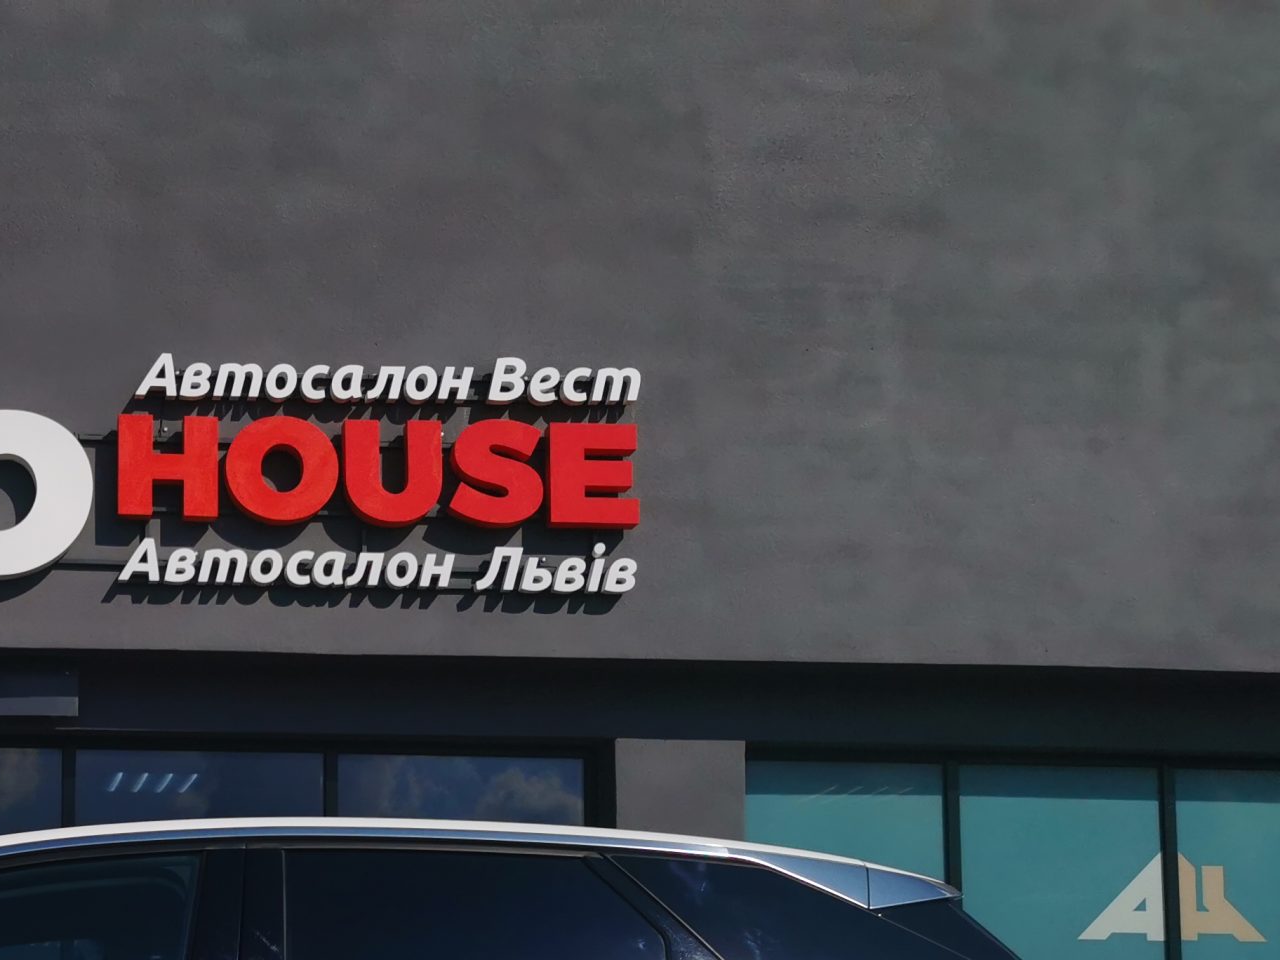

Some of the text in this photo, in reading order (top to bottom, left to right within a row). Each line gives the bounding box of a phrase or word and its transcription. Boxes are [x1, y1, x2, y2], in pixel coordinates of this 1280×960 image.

[135, 353, 642, 405] Автосалон Вест
[117, 413, 640, 529] HOUSE
[117, 538, 637, 594] Автосалон Львів
